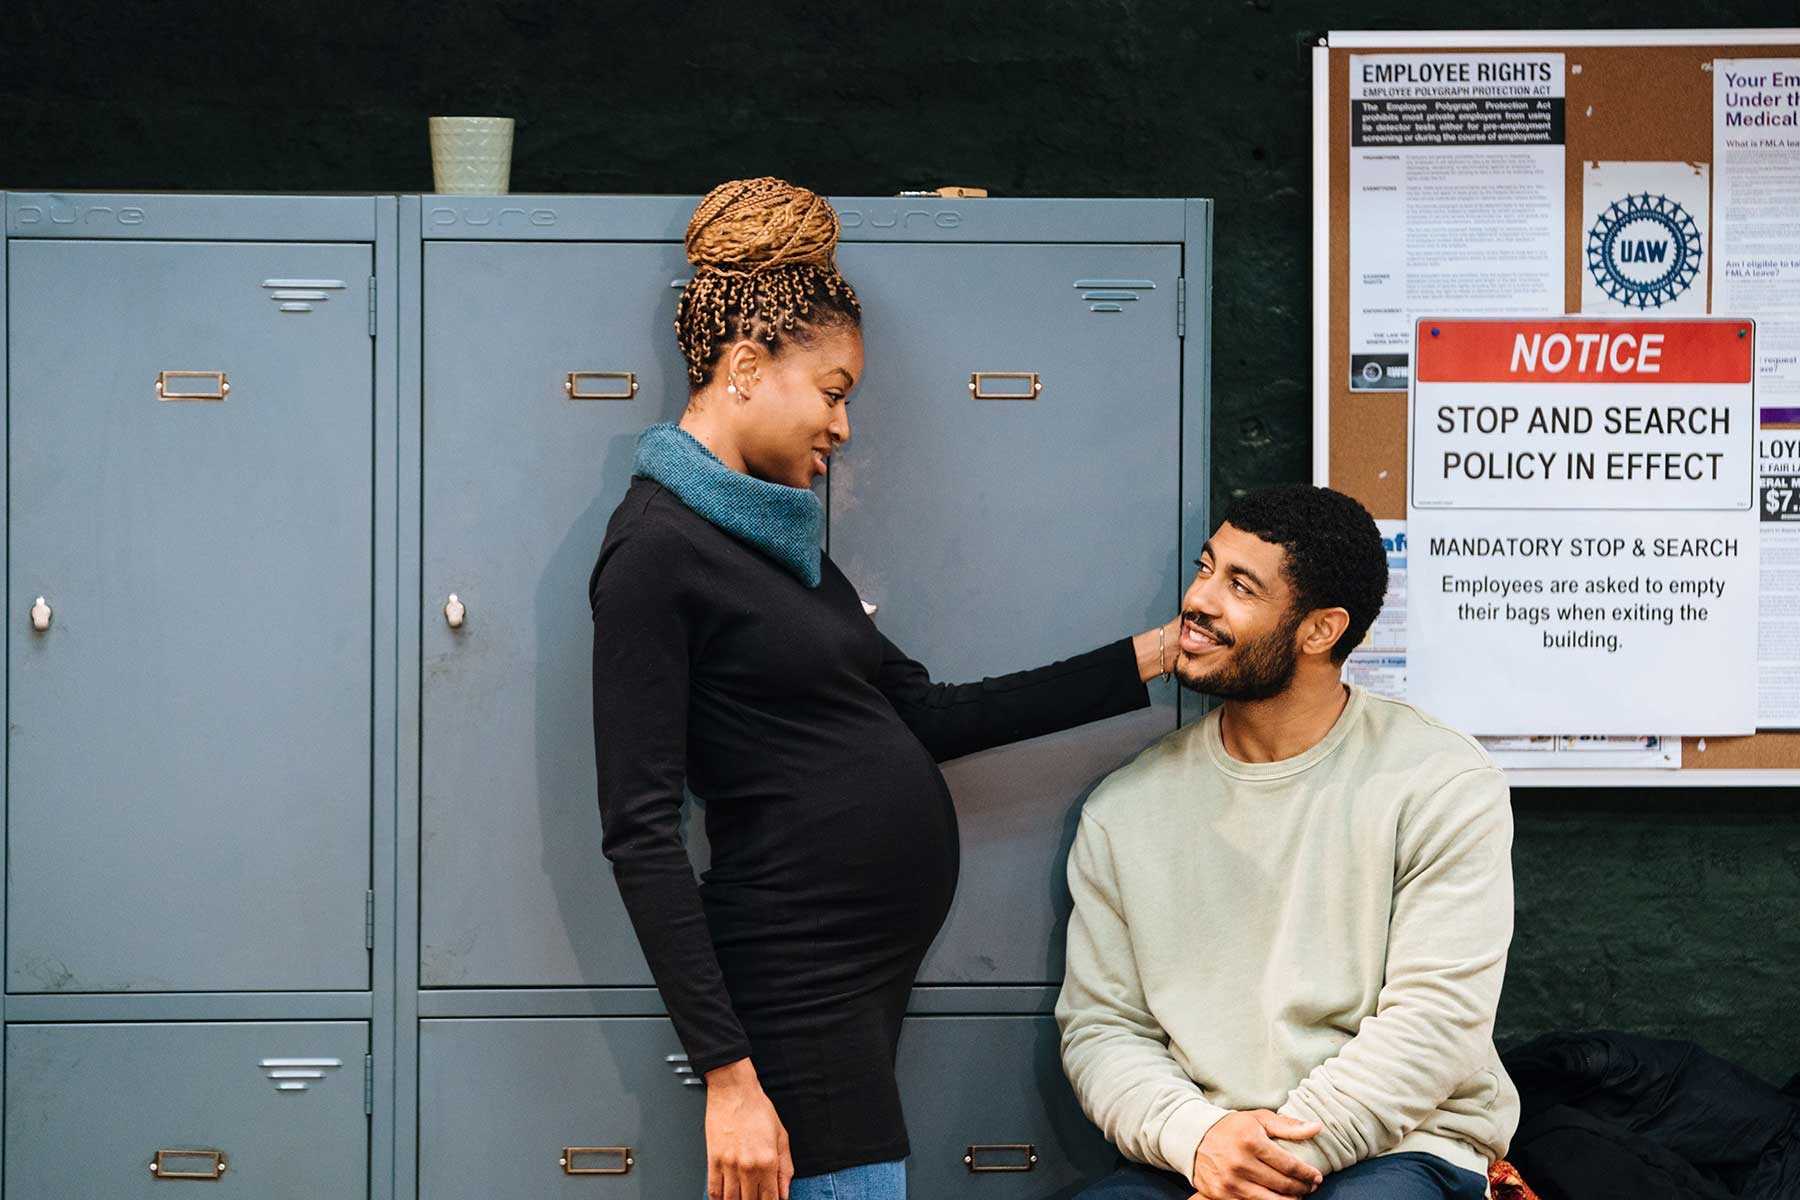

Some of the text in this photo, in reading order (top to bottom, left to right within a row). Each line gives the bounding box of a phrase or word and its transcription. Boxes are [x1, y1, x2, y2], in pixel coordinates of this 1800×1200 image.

[1362, 62, 1552, 82] EMPLOYEE RIGHTS
[1725, 72, 1800, 88] Your Em
[1362, 86, 1551, 97] EMPLOYEE POLYGRAPH PROTECTION ACT
[1726, 91, 1782, 108] Under
[1362, 101, 1552, 112] The Employee Polygraph Protection Act
[1362, 112, 1551, 122] prohibits most private employers from using
[1726, 111, 1798, 127] Medical
[1376, 124, 1412, 132] detector
[1483, 122, 1551, 132] pre-employment
[1362, 134, 1403, 143] screening
[1414, 134, 1442, 143] during
[1443, 132, 1456, 142] the
[1458, 134, 1486, 142] course
[1488, 132, 1496, 141] of
[1498, 132, 1552, 142] employment.
[1726, 140, 1748, 148] What
[1751, 140, 1758, 148] is
[1760, 140, 1784, 148] FMLA
[15, 205, 146, 230] pure
[430, 207, 558, 231] pure
[1620, 240, 1668, 263] UAW
[1510, 333, 1664, 373] NOTICE
[1437, 406, 1730, 434] STOP AND SEARCH
[1760, 440, 1800, 458] LOY
[1443, 452, 1724, 480] POLICY IN EFFECT
[1768, 464, 1790, 472] FAIR
[1766, 488, 1800, 515] $7.
[1382, 533, 1407, 552] af
[1430, 538, 1738, 557] MANDATORY STOP & SEARCH
[1442, 576, 1726, 598] Employees are asked to empty
[1458, 603, 1708, 625] their bags when exiting the
[1543, 630, 1623, 652] building.
